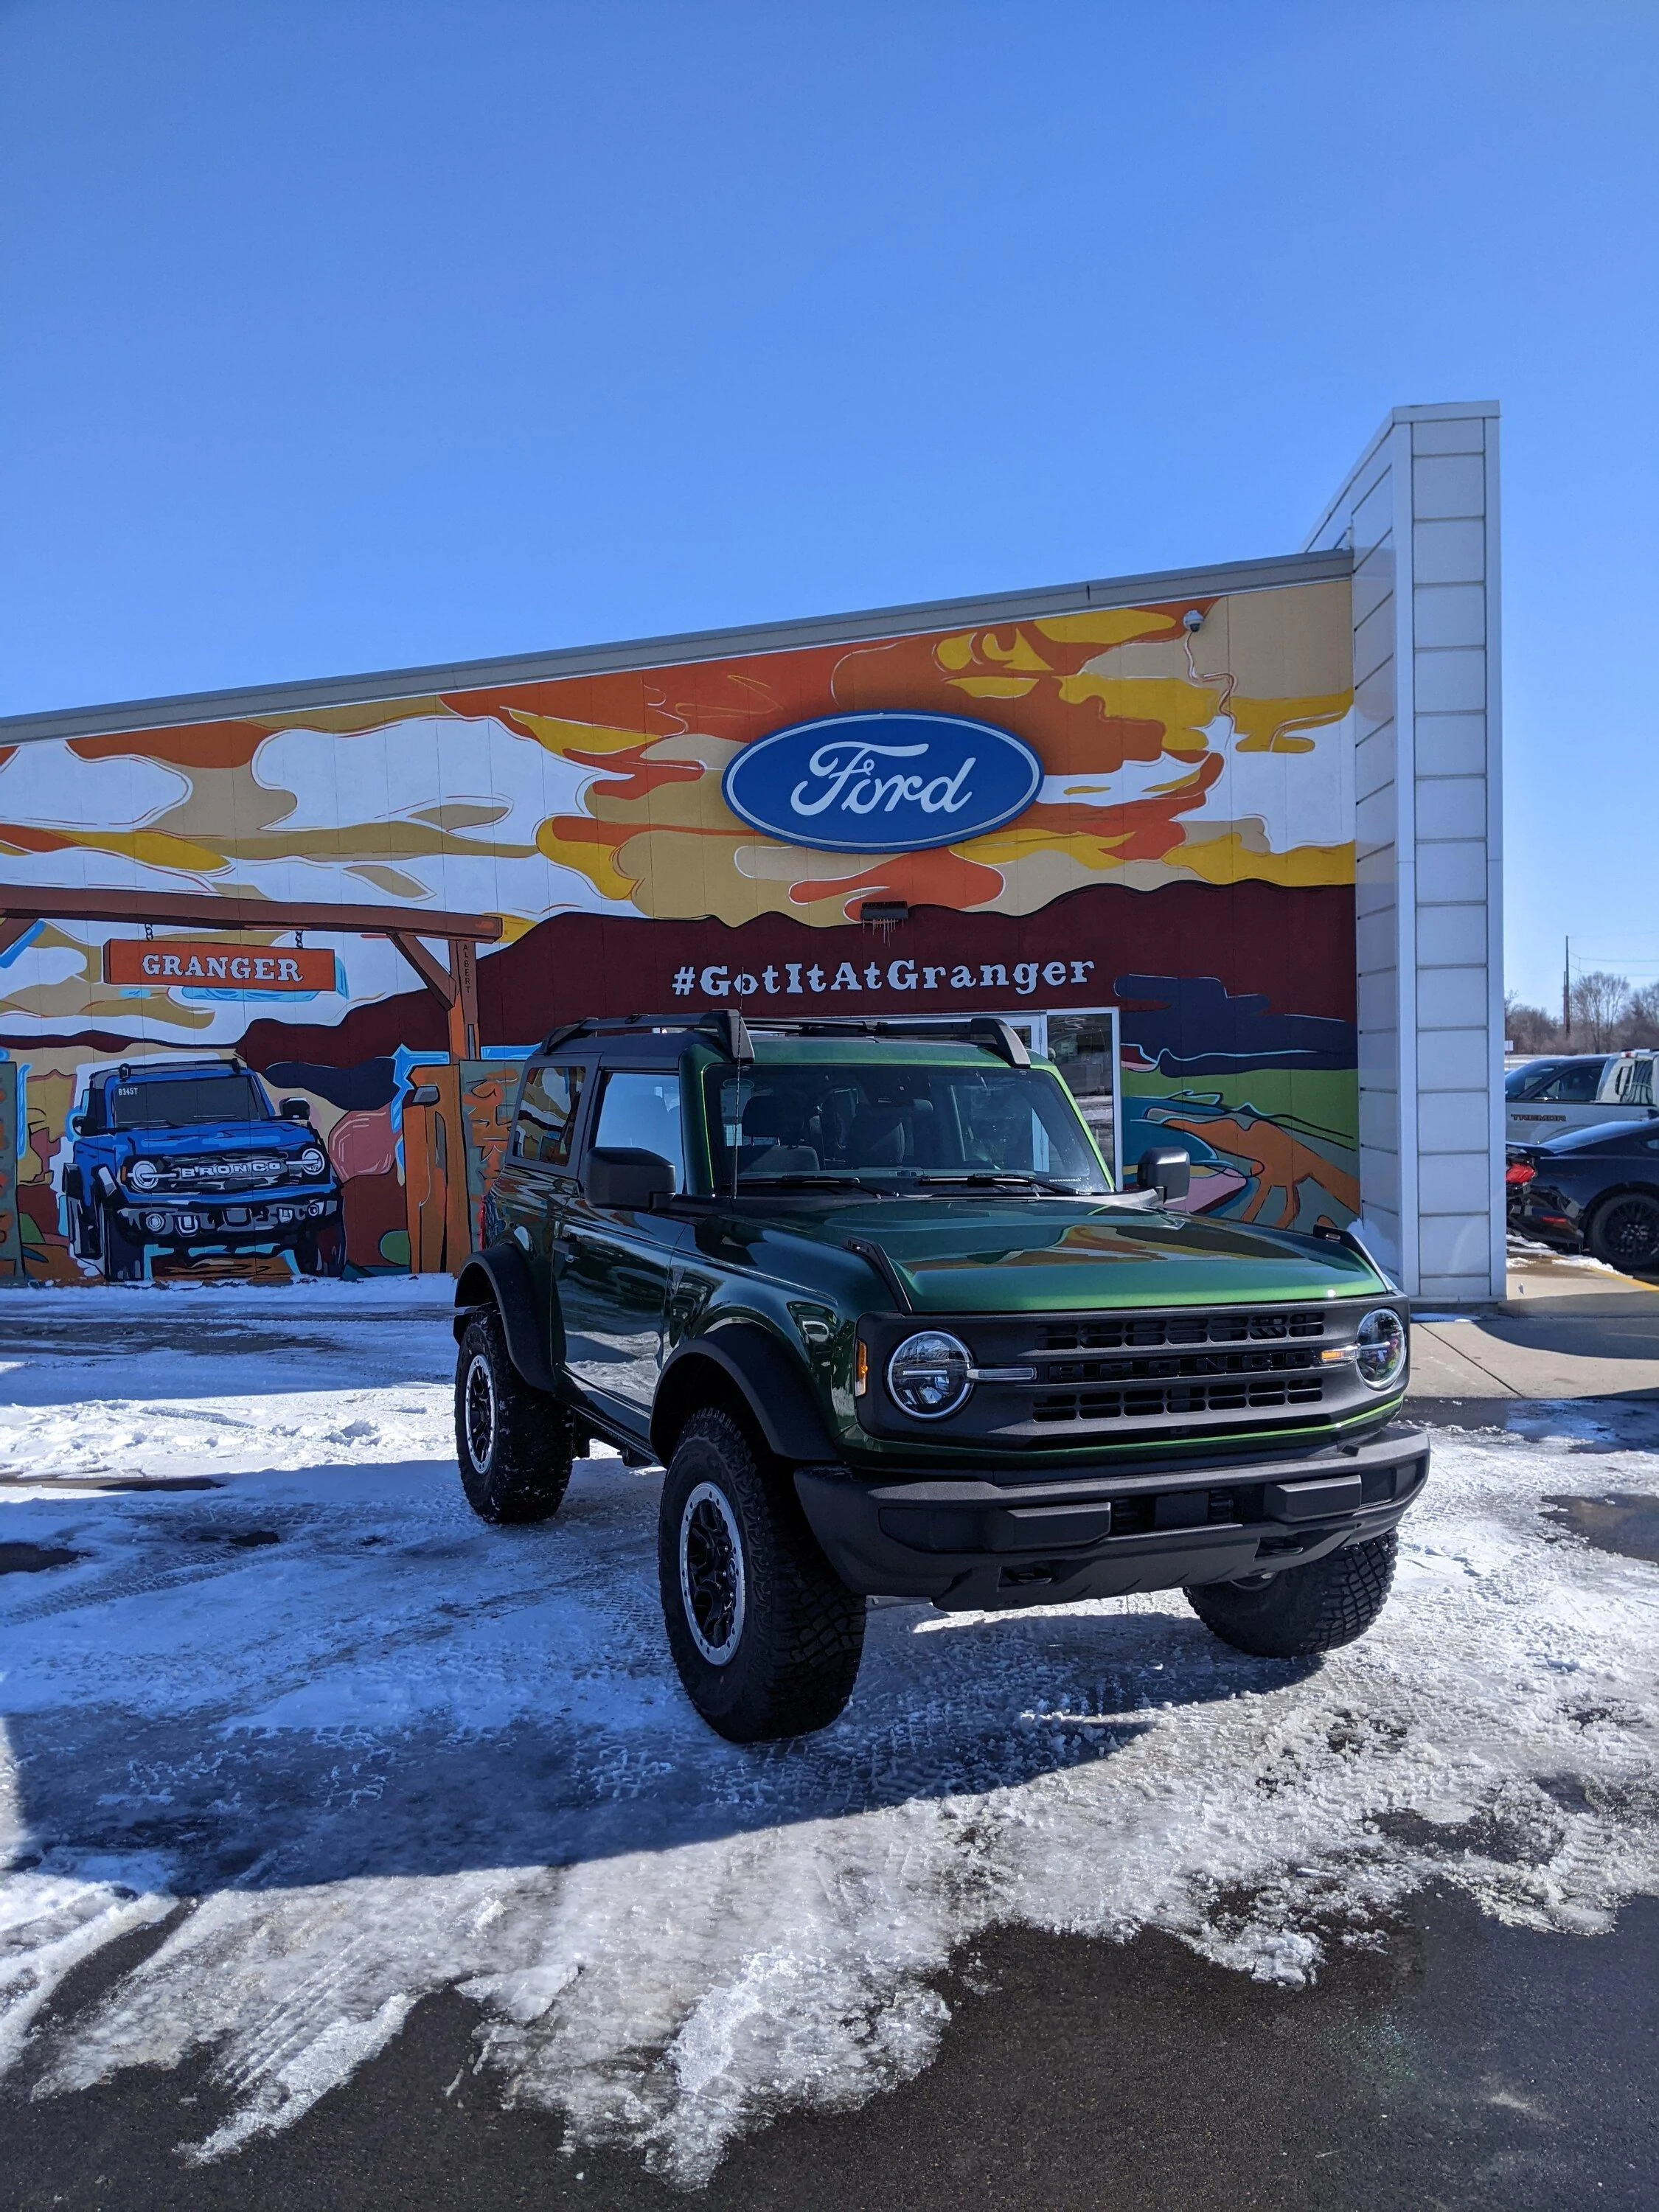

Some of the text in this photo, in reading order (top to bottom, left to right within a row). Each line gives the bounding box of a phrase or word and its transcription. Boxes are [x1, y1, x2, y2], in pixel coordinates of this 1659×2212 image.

[790, 741, 976, 815] Ford
[142, 954, 304, 982] GRANGER
[463, 944, 471, 993] ALBERT
[672, 959, 1095, 995] #GotItAtGranger
[181, 1162, 281, 1178] BRONCO
